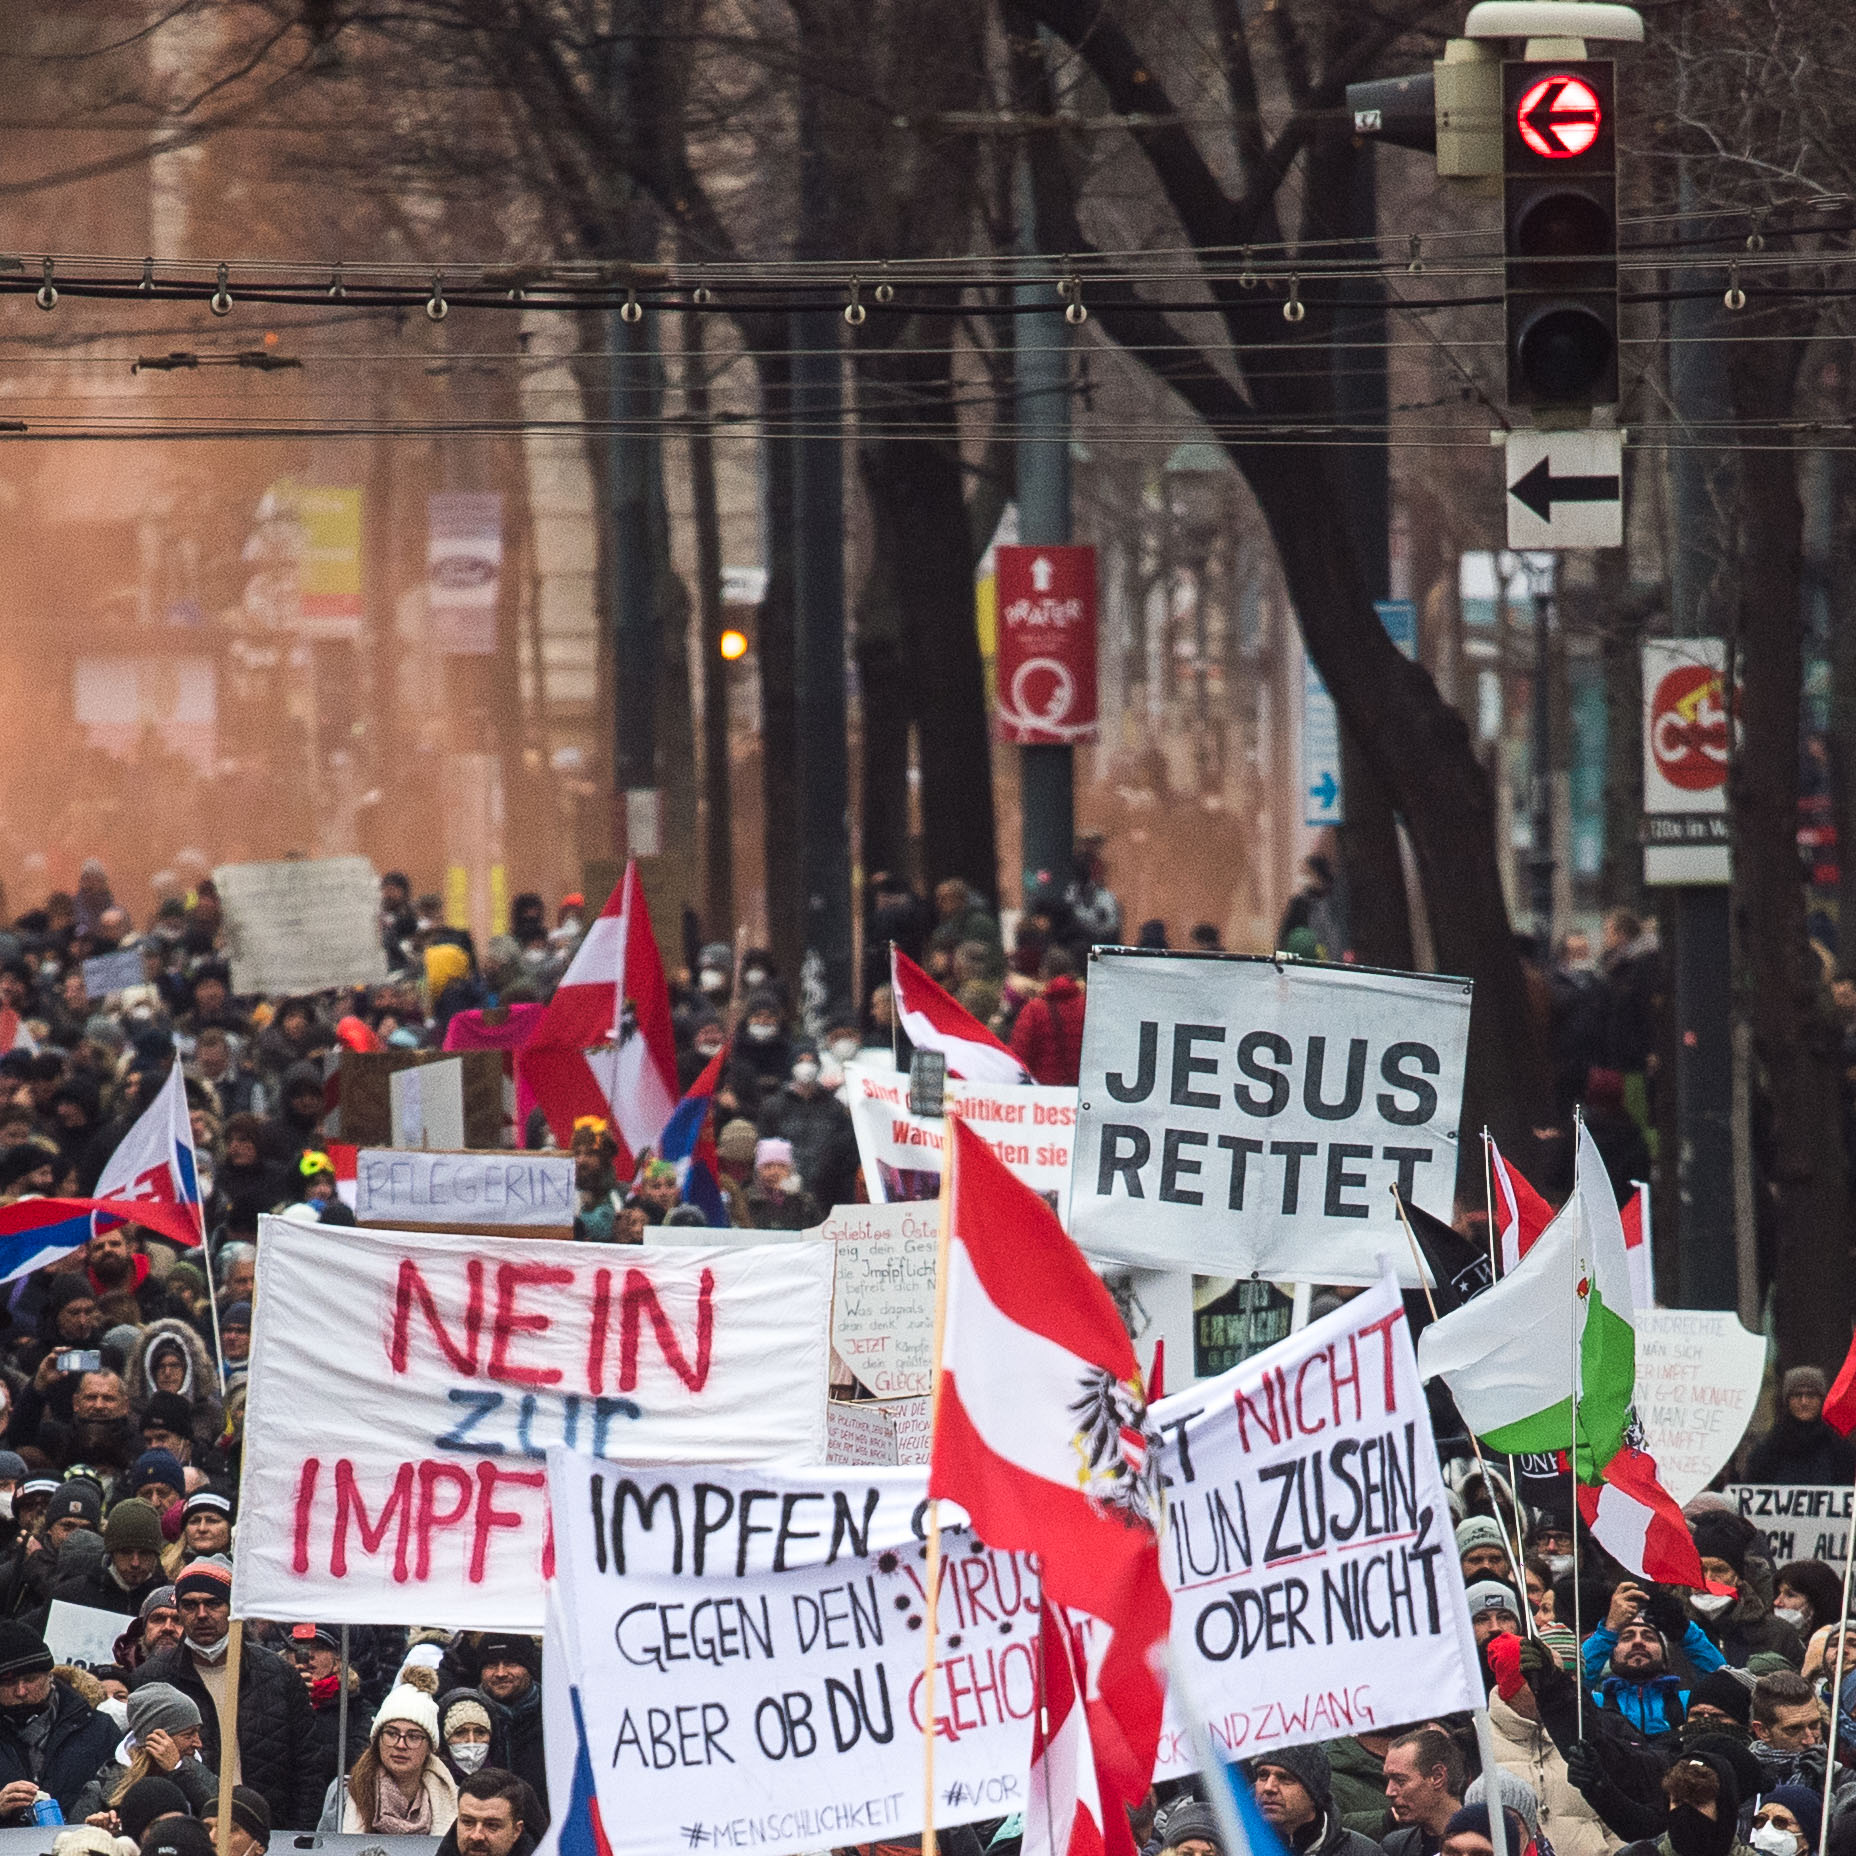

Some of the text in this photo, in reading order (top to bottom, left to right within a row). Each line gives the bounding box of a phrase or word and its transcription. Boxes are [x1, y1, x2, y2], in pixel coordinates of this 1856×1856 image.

[862, 1078, 899, 1104] Sind
[952, 1097, 1026, 1124] olitiker
[1105, 1020, 1441, 1126] JESUS
[367, 1160, 572, 1211] PFLEGERIN
[1036, 1142, 1068, 1167] sie
[1096, 1123, 1433, 1222] RETTET
[388, 1258, 715, 1394] NEIN
[844, 1336, 891, 1355] JETZT
[911, 1401, 927, 1417] DIE
[1234, 1305, 1405, 1453] NICHT
[292, 1457, 555, 1583] IMPF
[590, 1473, 880, 1577] IMPFEN
[1731, 1486, 1855, 1518] RZWEIFLE
[615, 1595, 775, 1673] GEGEN
[792, 1575, 884, 1655] DEN
[1196, 1544, 1442, 1662] ODER NICHT
[612, 1636, 1041, 1770] ABER OB DU GEHO
[680, 1792, 904, 1850] #MENSCHLICHKEIT
